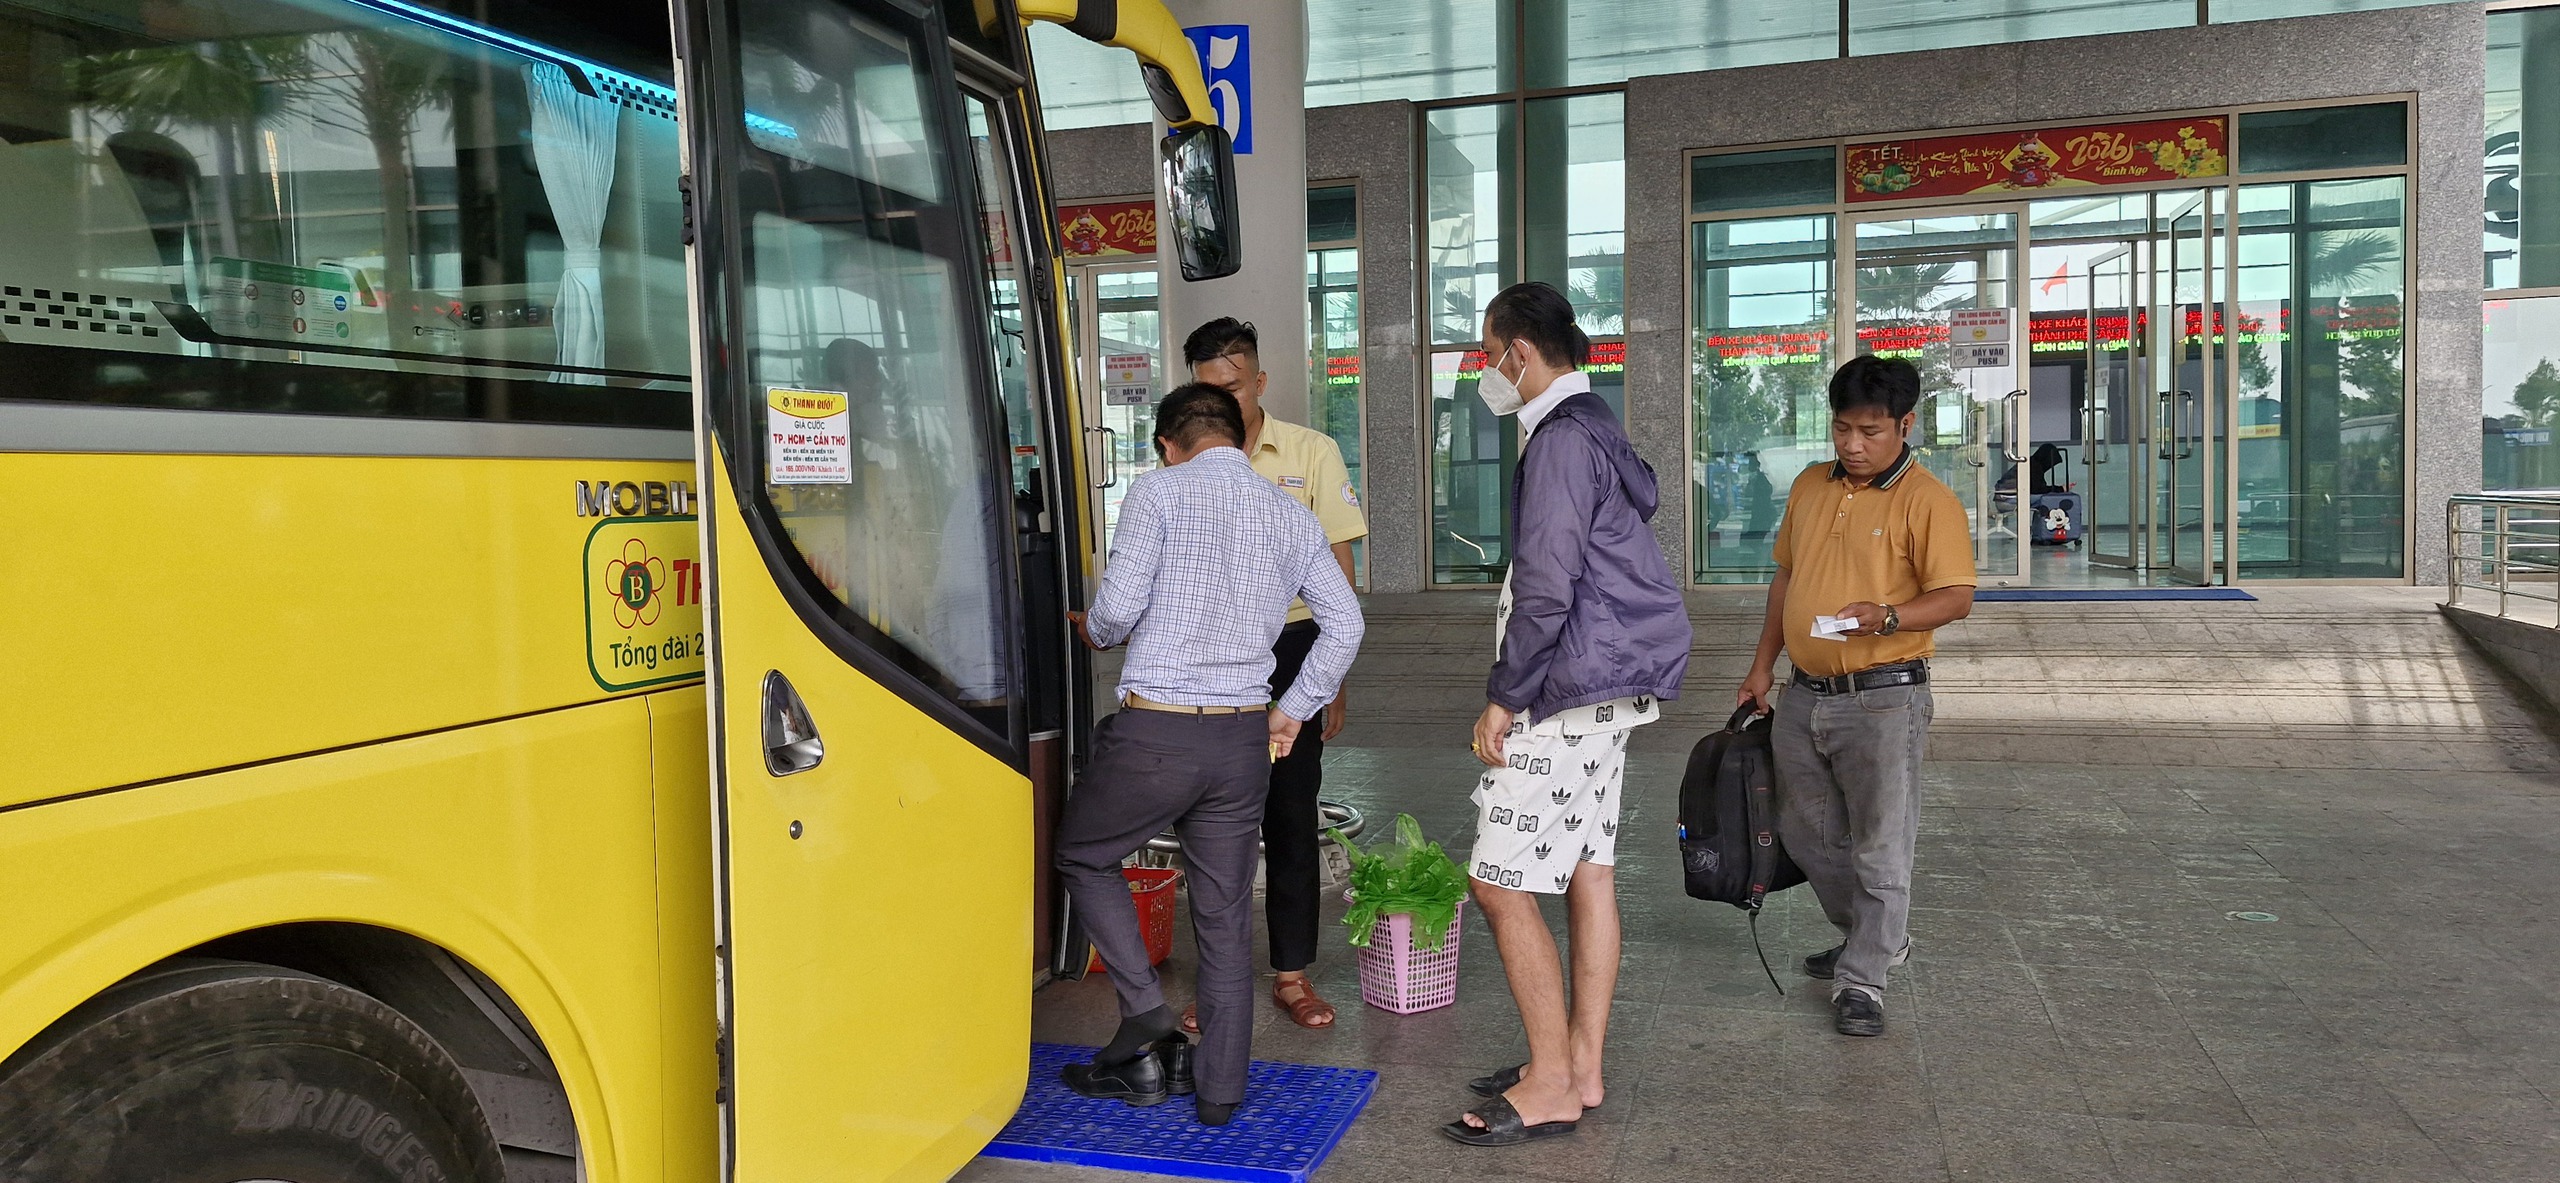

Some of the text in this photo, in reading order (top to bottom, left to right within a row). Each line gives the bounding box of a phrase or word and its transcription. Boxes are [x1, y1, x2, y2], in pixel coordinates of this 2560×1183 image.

[1871, 144, 1901, 160] TẾT
[2065, 132, 2133, 169] 2026
[2129, 165, 2148, 176] Ngọ
[1880, 328, 1892, 337] XE
[1728, 336, 1740, 345] XE
[1988, 347, 2004, 356] VÀO
[1978, 357, 1998, 365] PUSH
[773, 434, 786, 444] TP.
[788, 434, 805, 445] HCM
[609, 635, 657, 670] Tổng
[662, 634, 689, 660] đài
